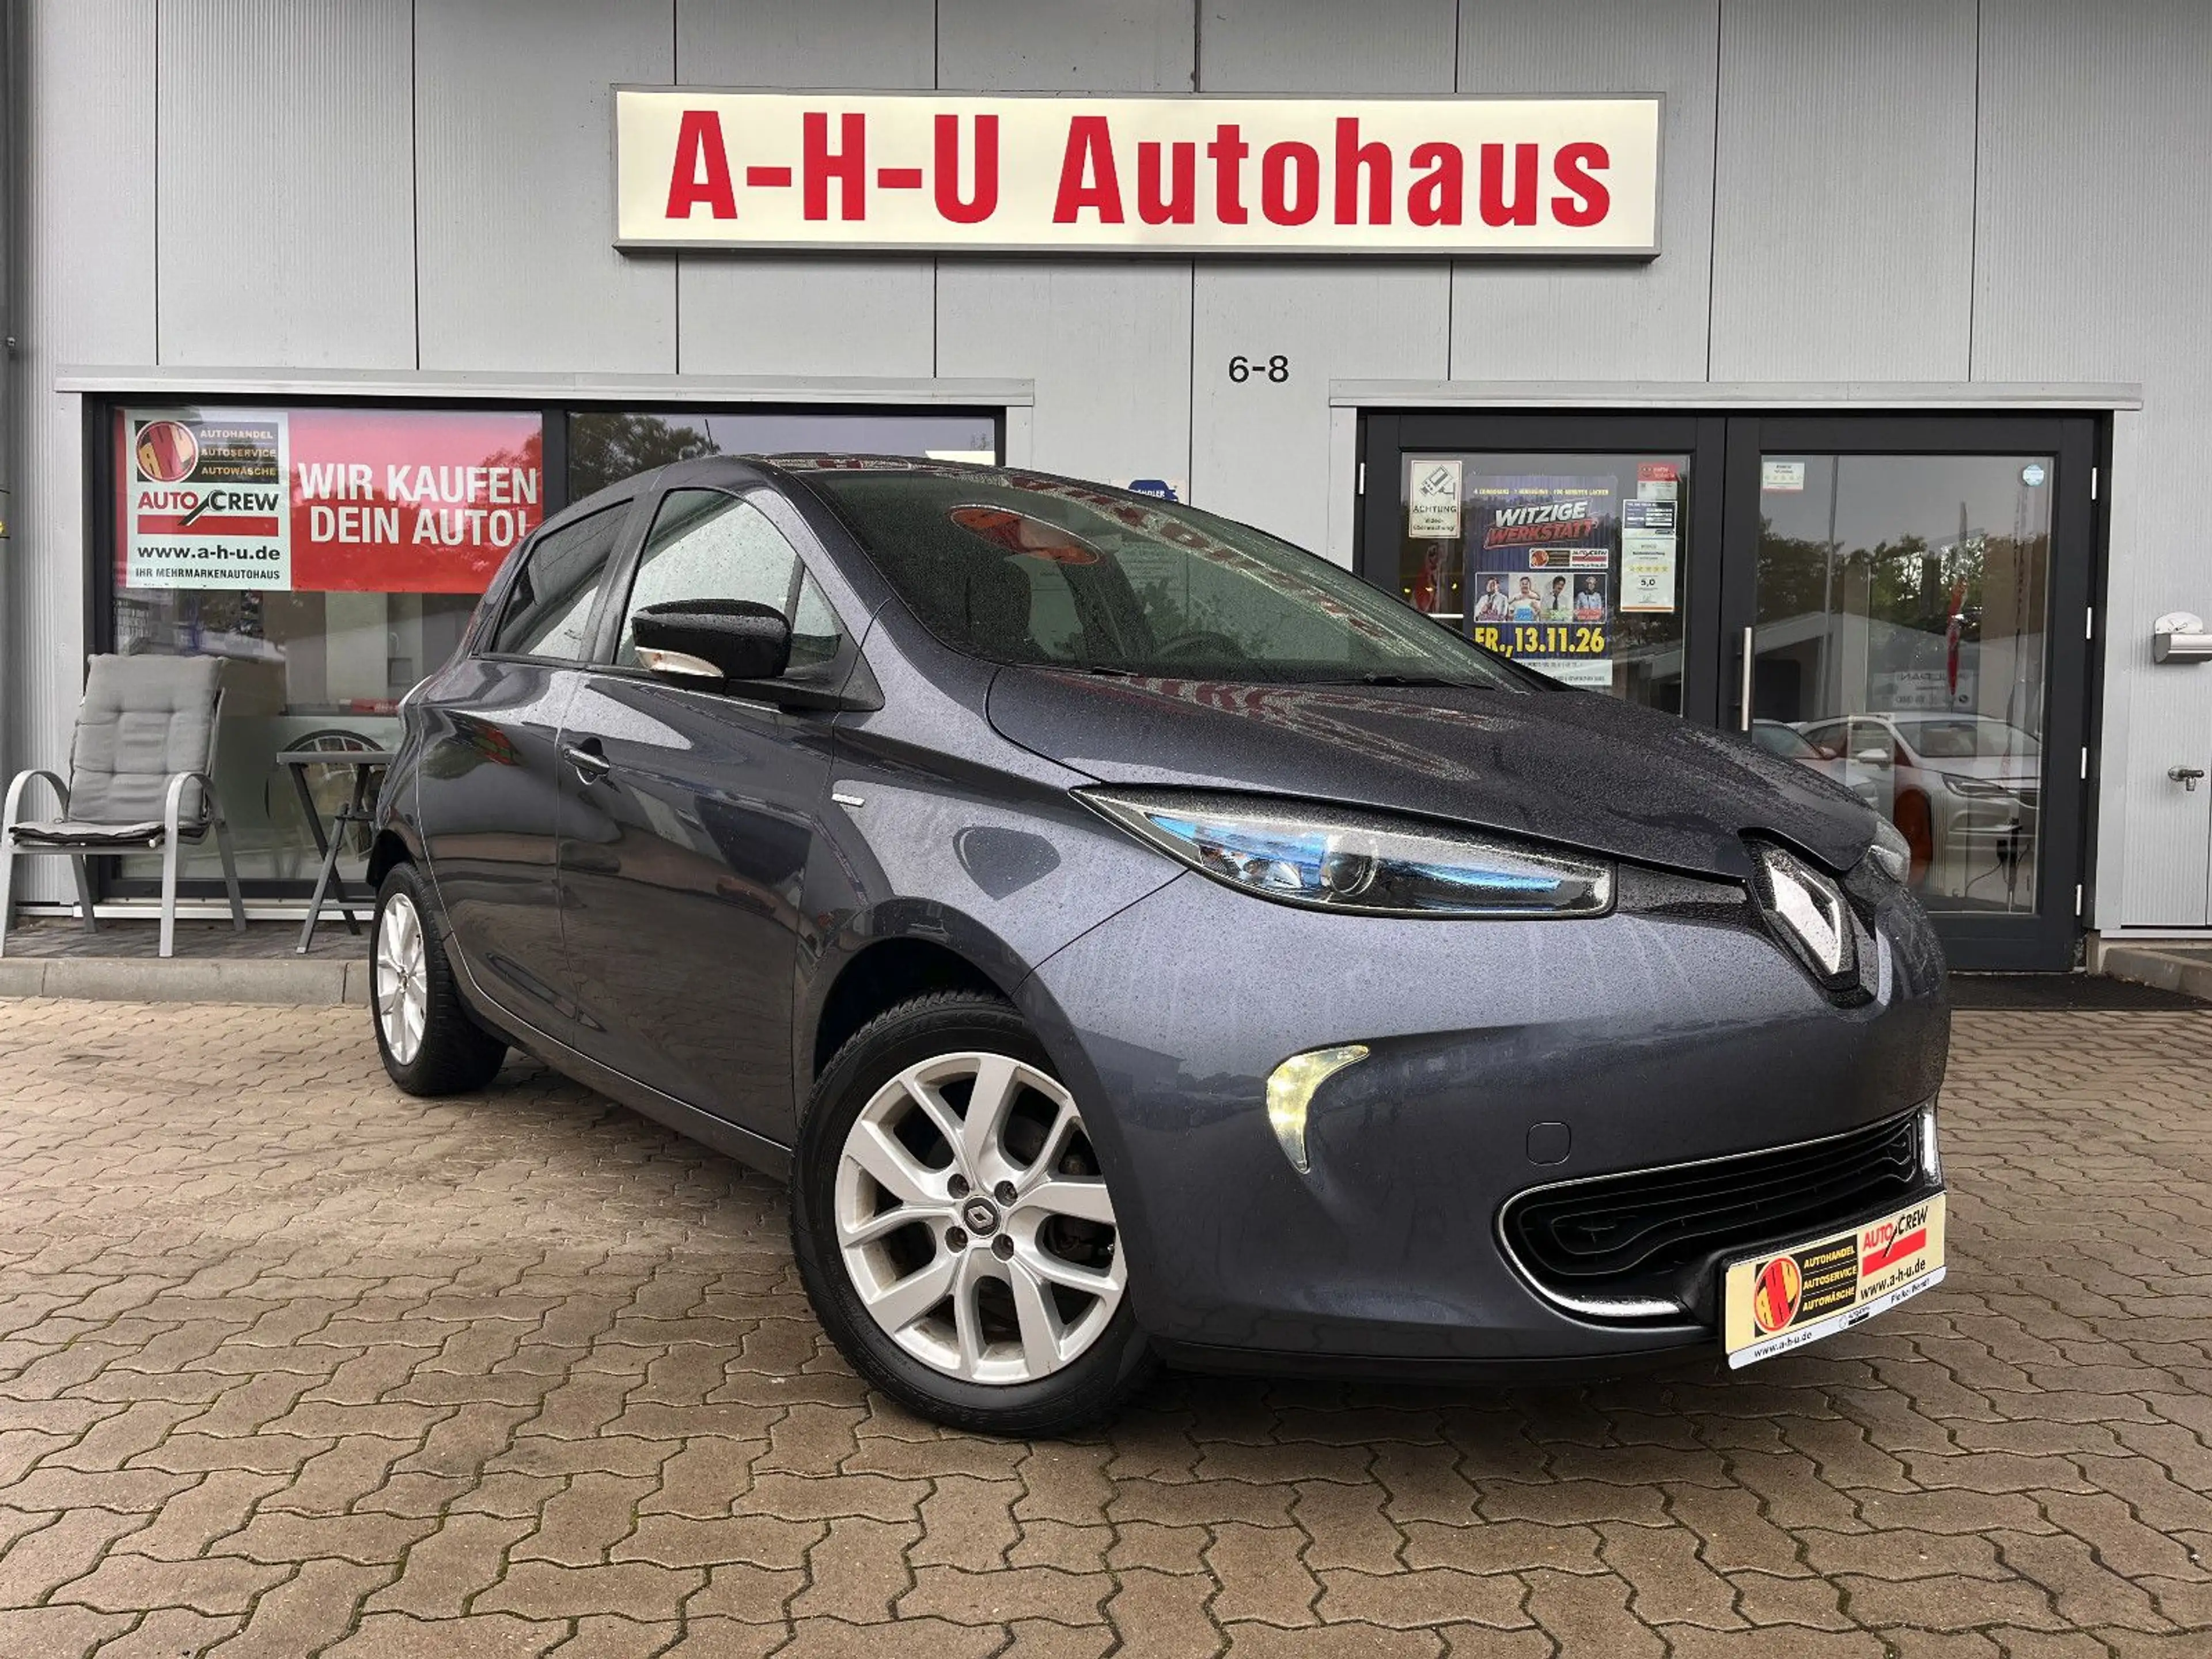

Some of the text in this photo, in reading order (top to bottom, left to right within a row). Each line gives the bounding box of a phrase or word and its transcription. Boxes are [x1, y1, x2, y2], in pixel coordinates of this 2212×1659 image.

[665, 110, 1610, 227] A-H-U Autohaus
[1229, 355, 1289, 382] 6-8
[200, 430, 273, 439] AUTOHANDEL
[200, 448, 276, 457] AUTOSERVICE
[201, 465, 276, 475] AUTOWÄSCHE
[298, 463, 537, 505] WIR KAUFEN
[138, 490, 279, 511] AUTO CREW
[310, 506, 526, 547] DEIN AUTO!
[1496, 501, 1588, 528] WITZIGE
[1488, 520, 1593, 546] WERKSTATT
[138, 545, 280, 560] www.a-h-u.de
[136, 568, 280, 579] IHR MEHRMARKENAUTOHAUS
[1641, 578, 1656, 586] 5,0
[1515, 627, 1605, 653] 13.11.26
[1862, 1205, 1929, 1252] AUTO CREW
[1804, 1245, 1855, 1268] AUTOHANDEL
[1802, 1265, 1858, 1291] AUTOSERVICE
[1860, 1258, 1926, 1300] www.a-h-u.de
[1802, 1286, 1855, 1312] AUTOWÄSCHE
